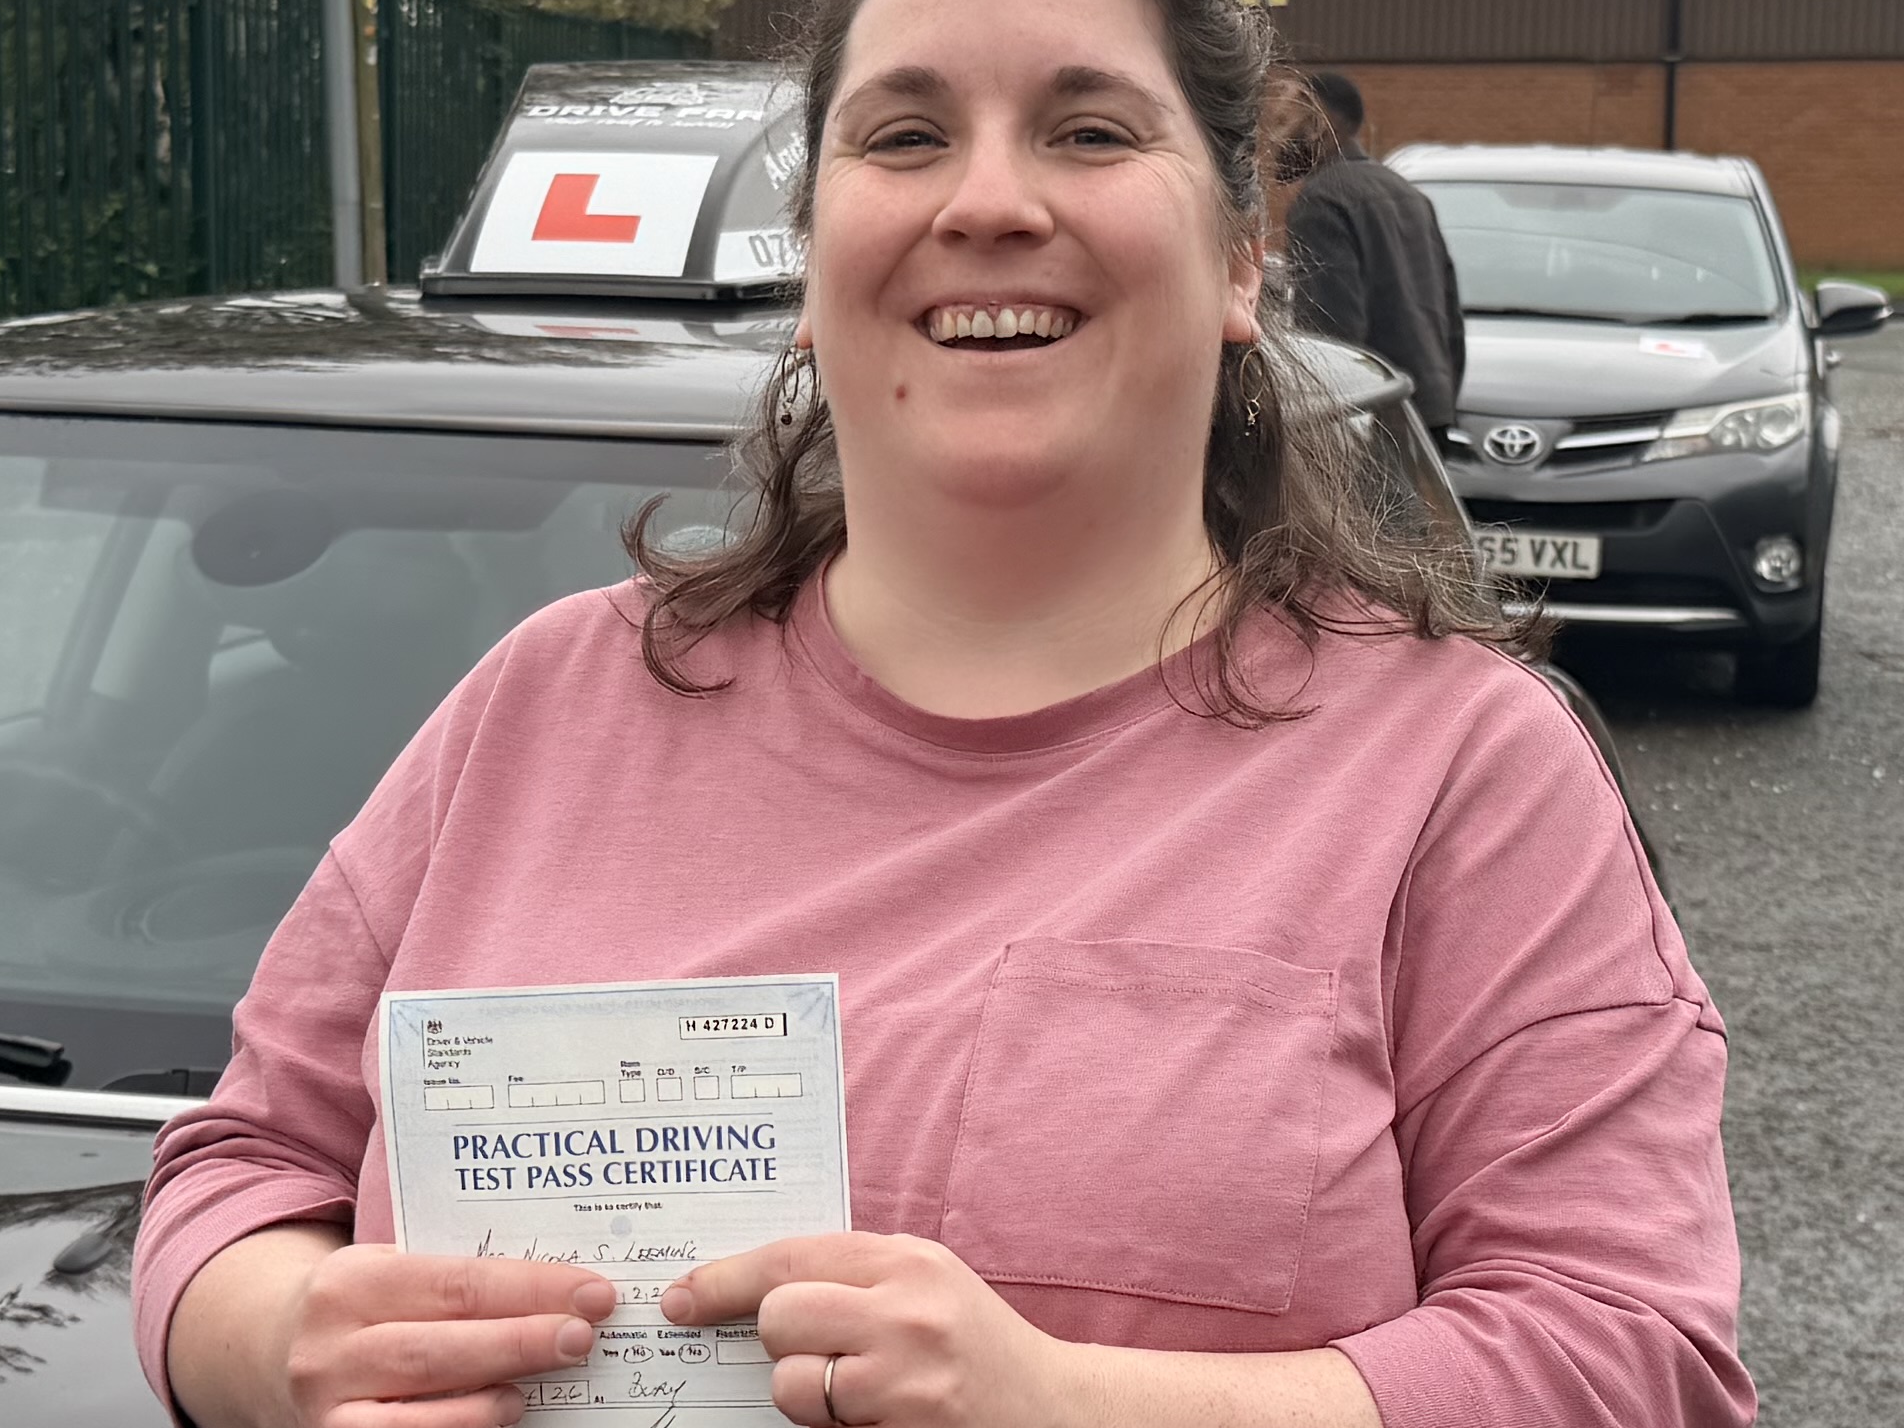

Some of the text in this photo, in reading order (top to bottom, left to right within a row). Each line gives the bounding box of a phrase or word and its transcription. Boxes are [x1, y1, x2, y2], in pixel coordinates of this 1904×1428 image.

[528, 105, 666, 117] DRIVE
[531, 173, 641, 243] L
[1529, 538, 1590, 570] VXL
[686, 1017, 775, 1032] H 427224 D
[453, 1123, 776, 1160] PRACTICAL DRIVING
[454, 1157, 777, 1191] TEST PASS CERTIFICATE
